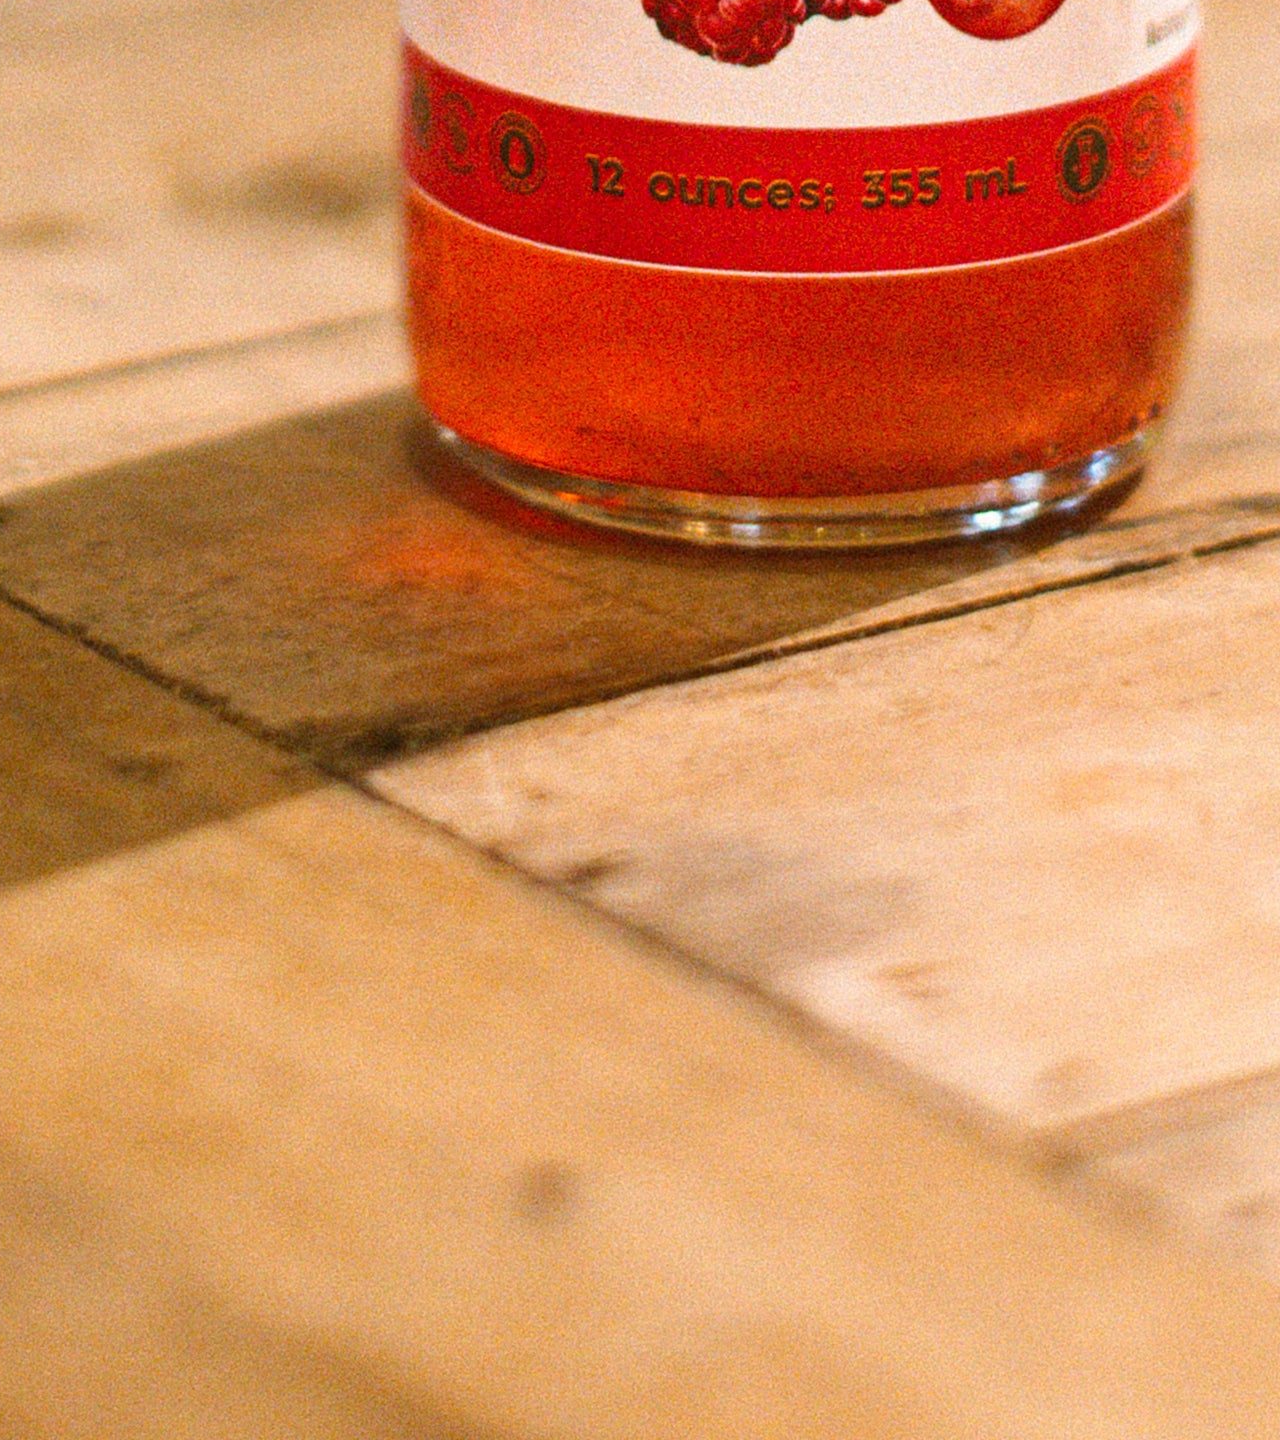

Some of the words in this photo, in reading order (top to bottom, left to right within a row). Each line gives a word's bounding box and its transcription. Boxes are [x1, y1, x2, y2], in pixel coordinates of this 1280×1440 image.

[584, 153, 624, 197] 12
[862, 166, 941, 210] 355
[964, 156, 1027, 202] mL
